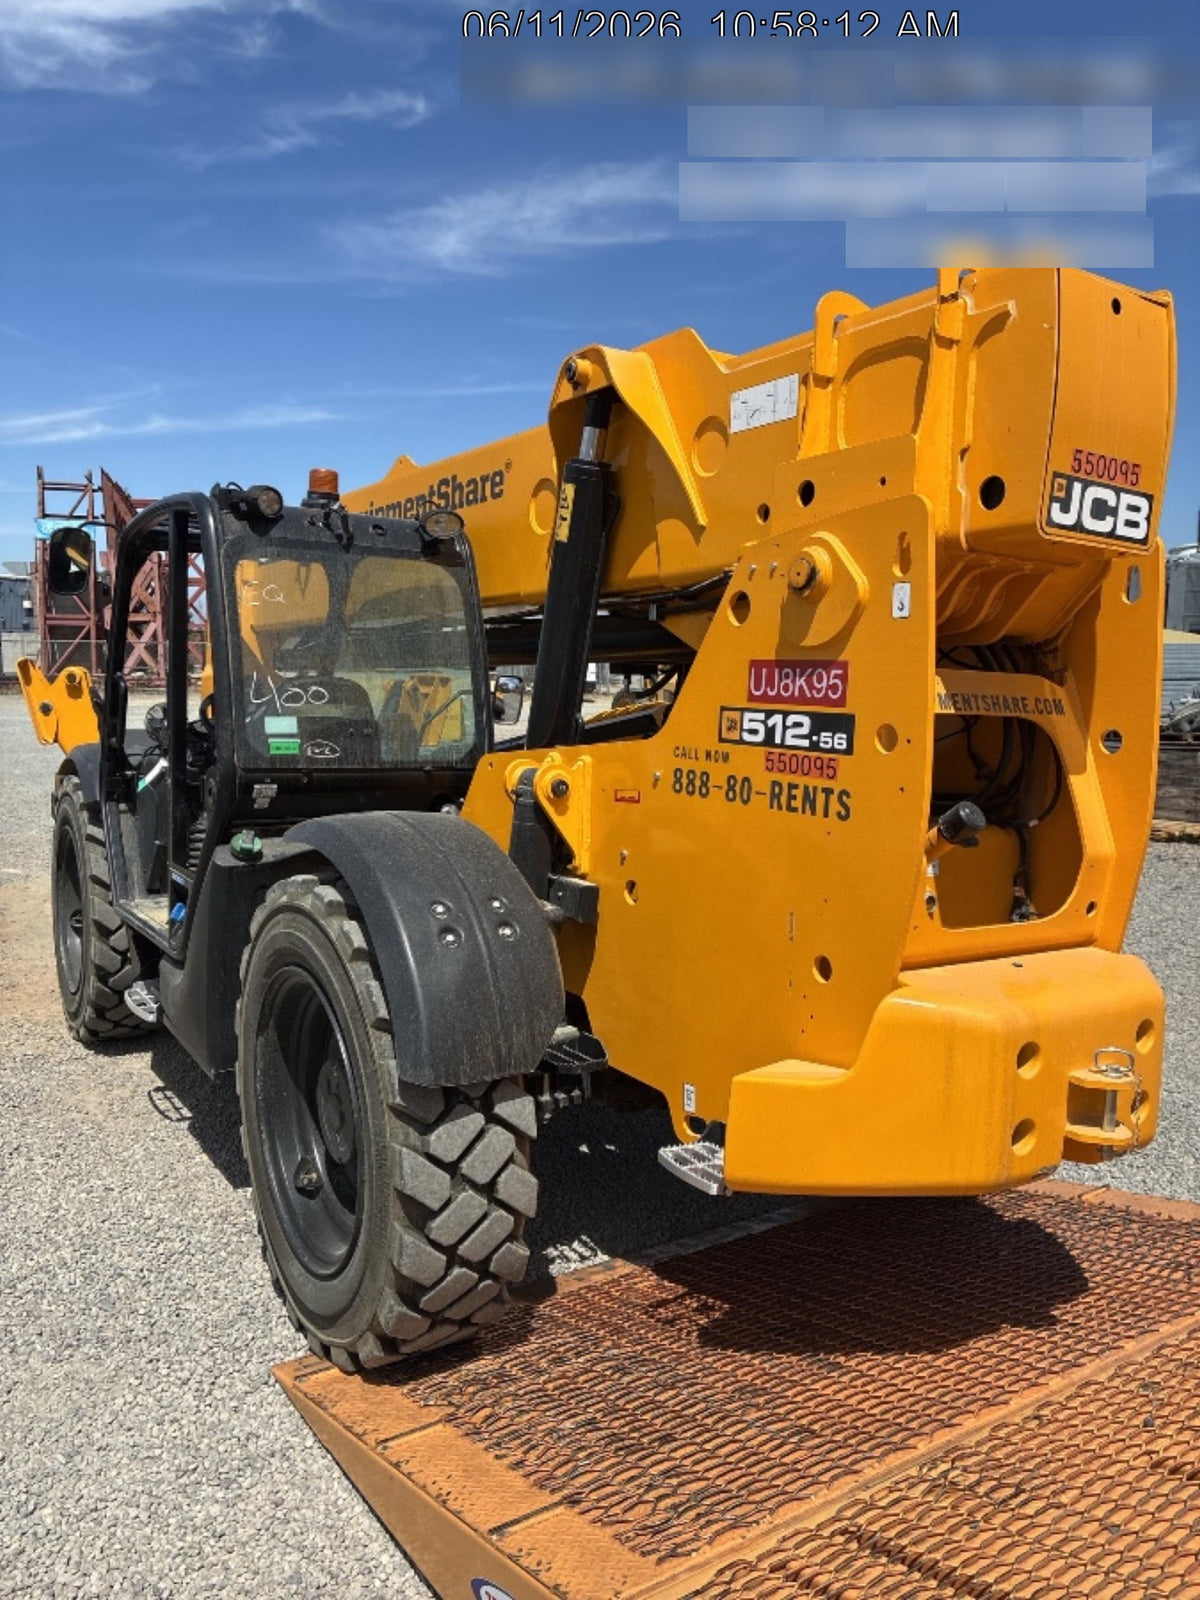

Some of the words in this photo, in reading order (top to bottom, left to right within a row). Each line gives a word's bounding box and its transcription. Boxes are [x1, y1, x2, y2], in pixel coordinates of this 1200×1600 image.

[1072, 449, 1141, 486] 550095
[1050, 481, 1149, 539] JCB
[250, 671, 329, 713] 400
[750, 667, 843, 699] UJ8K95
[673, 746, 699, 761] CALL
[705, 750, 729, 763] NOW
[766, 752, 838, 779] 550095
[673, 767, 852, 822] 888-80-RENTS
